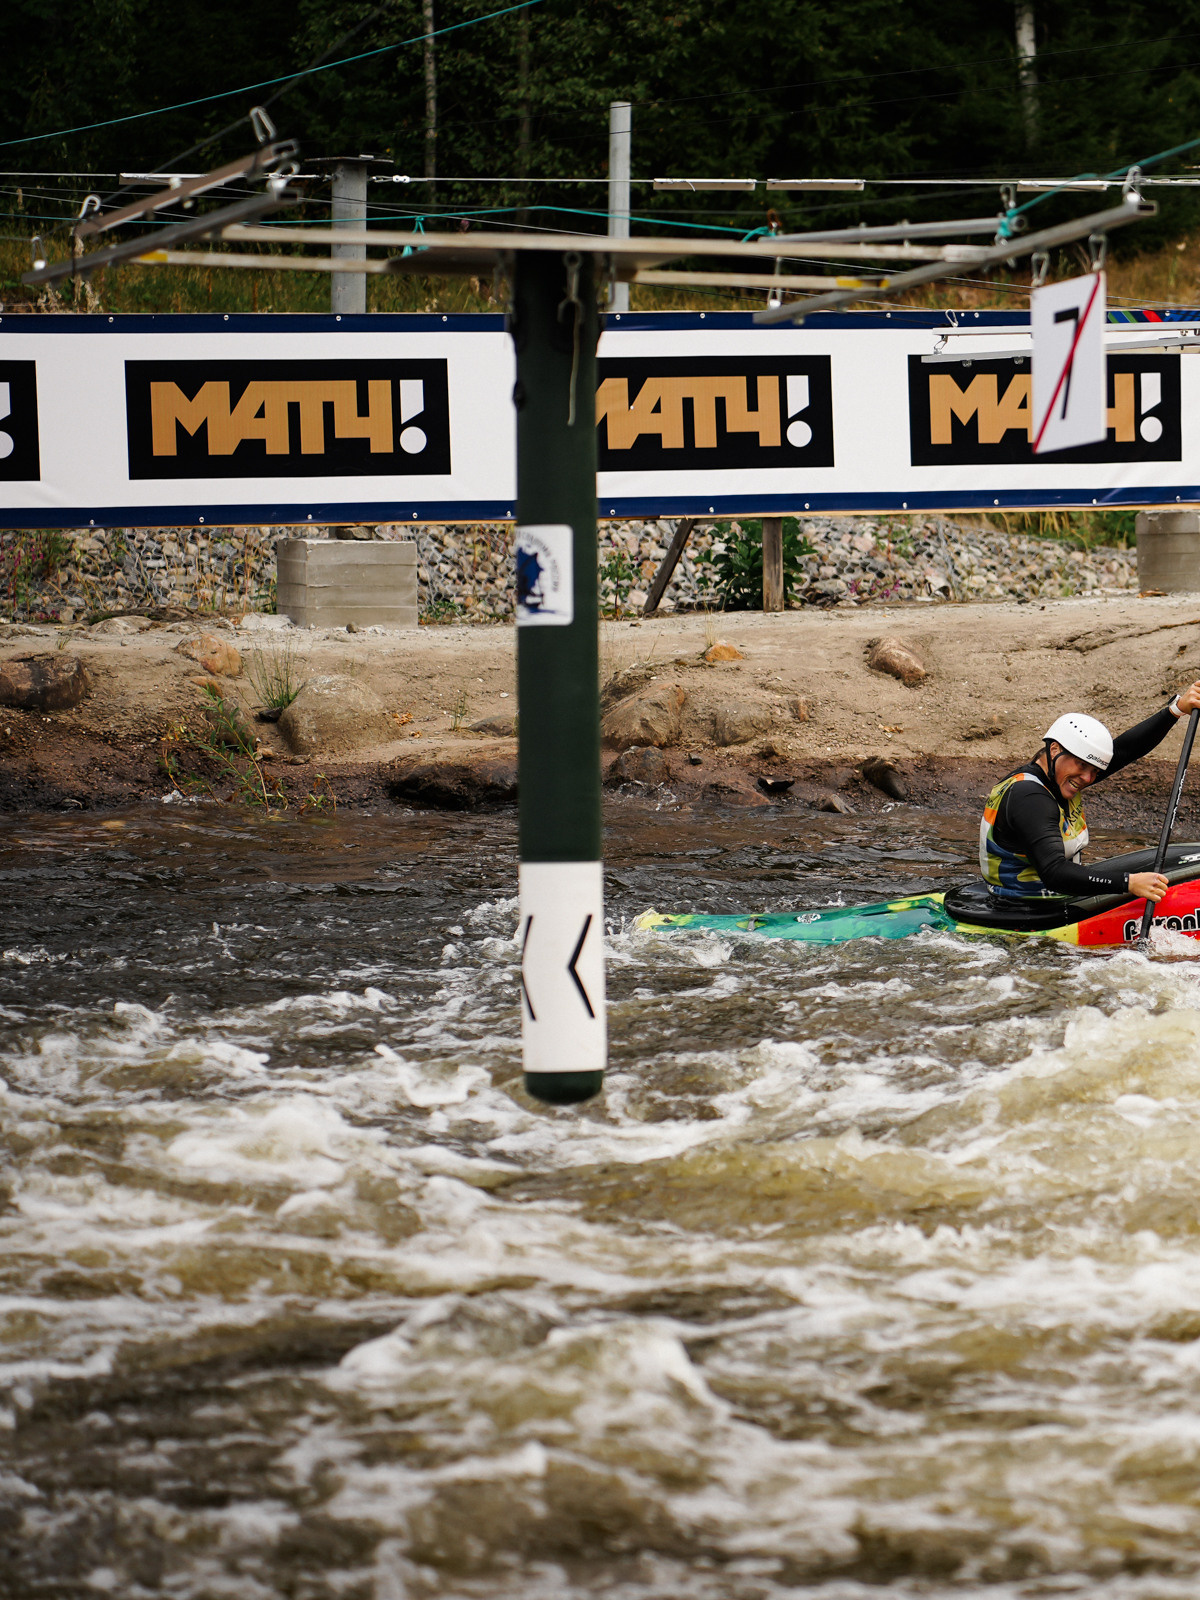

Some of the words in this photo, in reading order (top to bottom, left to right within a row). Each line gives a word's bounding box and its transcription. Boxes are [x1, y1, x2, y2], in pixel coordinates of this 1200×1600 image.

[1054, 306, 1080, 421] 7
[150, 379, 428, 456] МАТЧ!
[929, 372, 1163, 445] МАЧ!
[1088, 875, 1112, 884] KIPSTA
